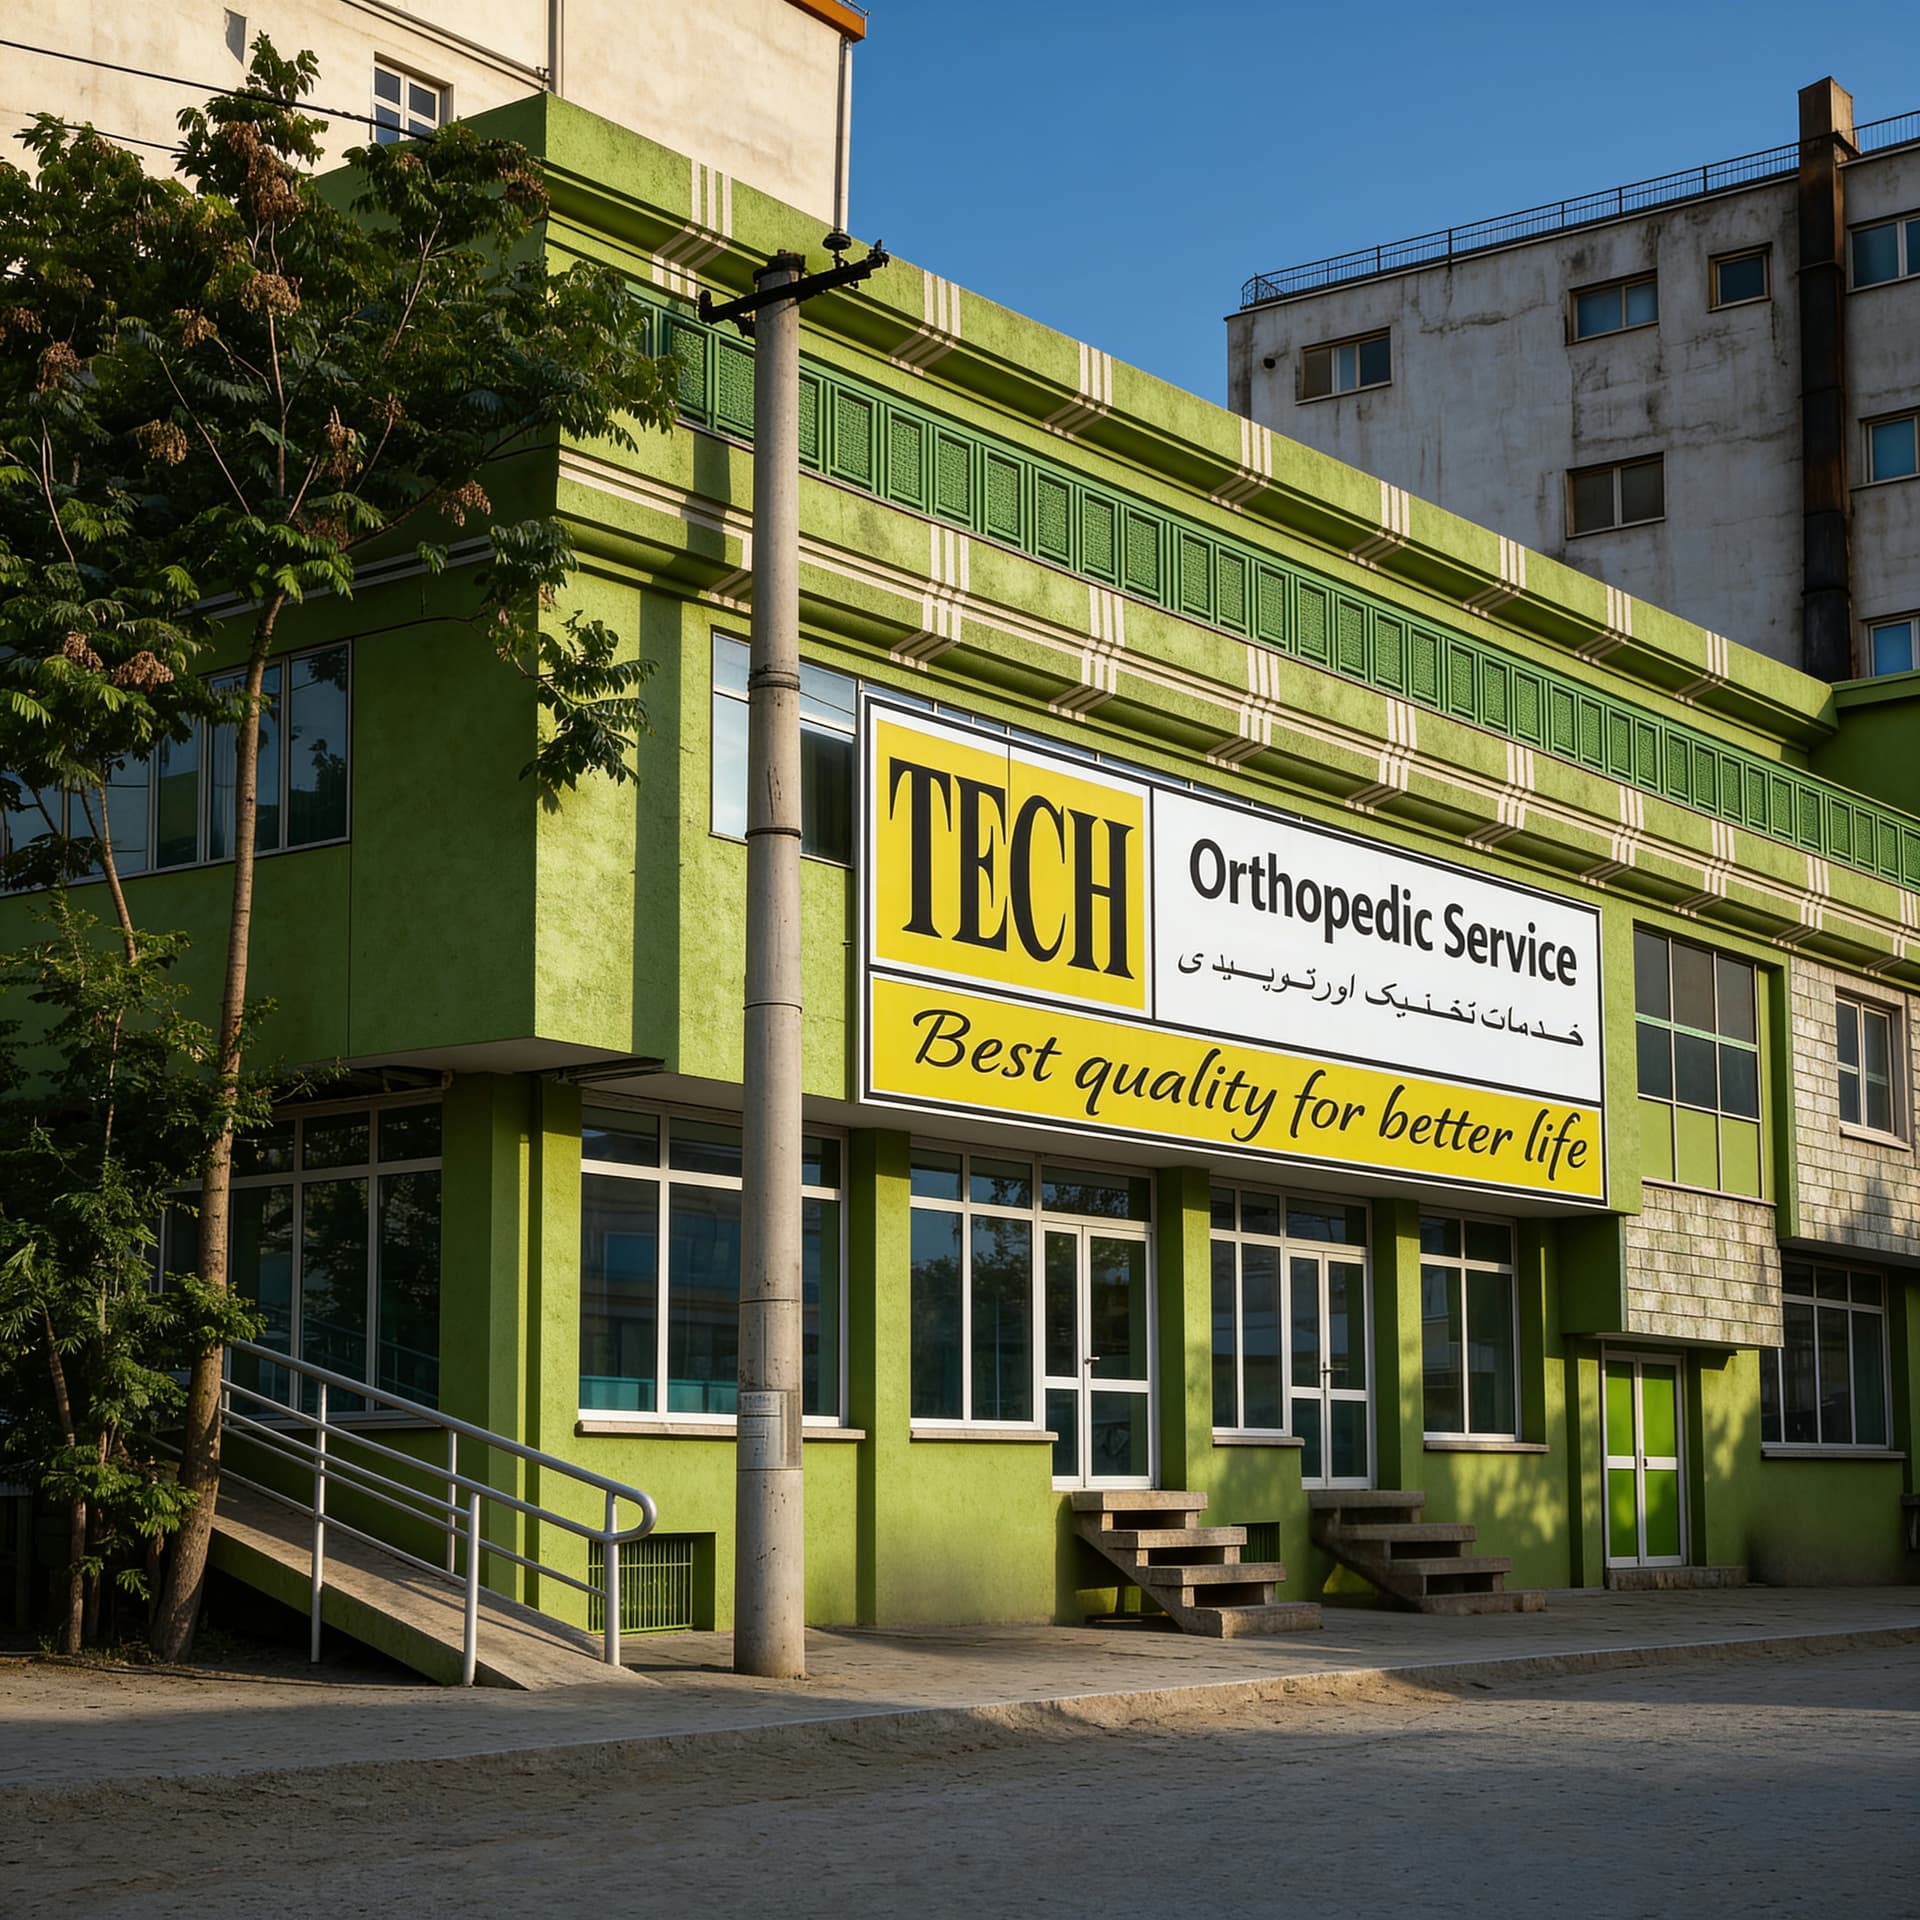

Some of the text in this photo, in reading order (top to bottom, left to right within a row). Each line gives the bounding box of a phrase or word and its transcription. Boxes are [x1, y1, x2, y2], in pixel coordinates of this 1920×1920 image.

[888, 756, 1135, 980] TECH
[1189, 838, 1578, 987] Orthopedic Service
[912, 1009, 1588, 1182] Best quality for better life
[1481, 1005, 1585, 1047] خدمات
